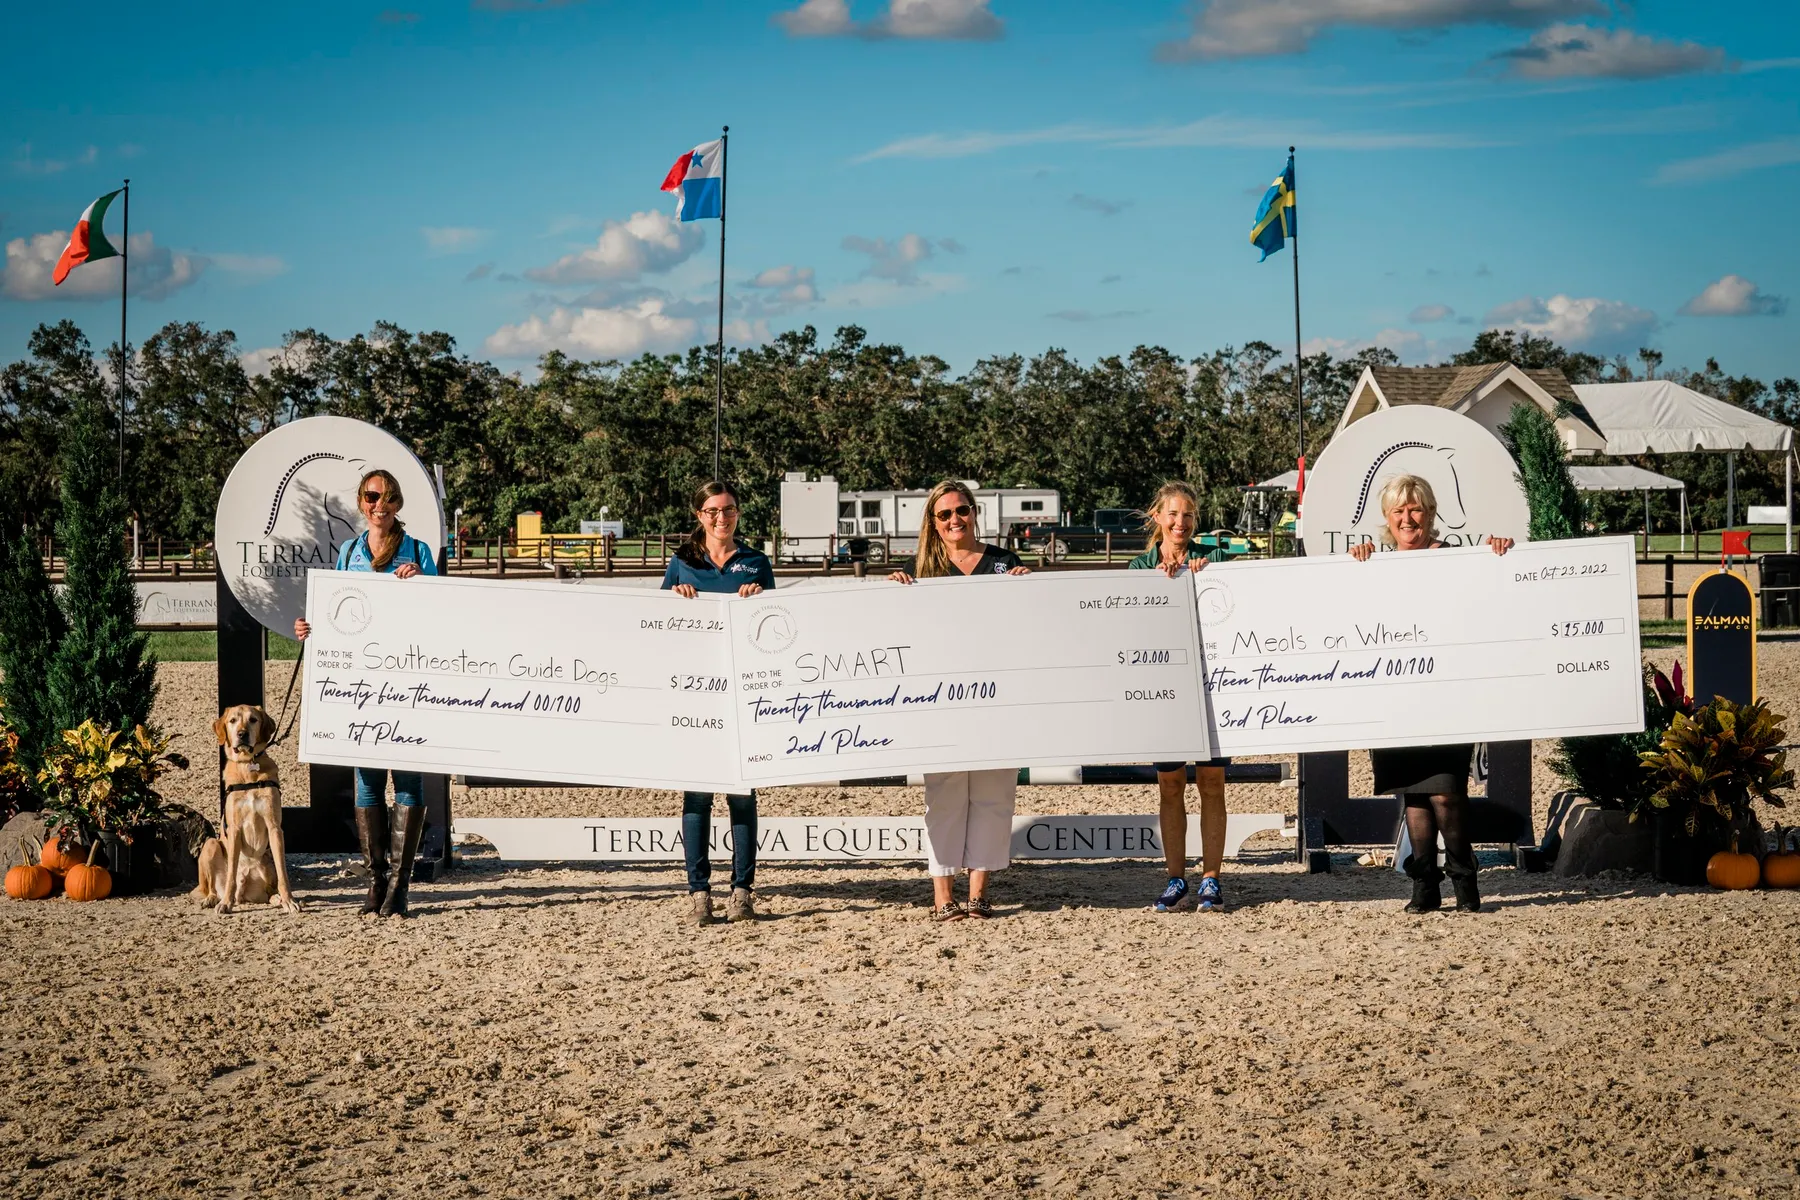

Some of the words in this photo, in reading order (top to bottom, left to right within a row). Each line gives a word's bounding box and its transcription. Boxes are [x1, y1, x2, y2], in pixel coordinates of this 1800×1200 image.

[236, 541, 340, 563] TERRAN
[1515, 572, 1538, 582] DATE
[1581, 563, 1608, 575] 2022
[1079, 600, 1102, 610] DATE
[1144, 595, 1169, 606] 2022
[640, 620, 663, 630] DATE
[1551, 623, 1559, 637] $
[1232, 627, 1307, 655] Meals
[1324, 635, 1348, 649] on
[1355, 623, 1429, 645] Wheels
[317, 650, 328, 658] PAY
[331, 650, 340, 658] TO
[342, 651, 353, 659] THE
[1118, 651, 1125, 665] $
[317, 660, 340, 669] ORDER
[363, 642, 498, 675] Southeastern
[508, 654, 563, 679] Guide
[574, 658, 619, 695] Dogs
[795, 646, 911, 683] SMART
[1252, 659, 1340, 690] thousand
[1341, 657, 1382, 680] and
[1385, 656, 1434, 675] 00/100
[1557, 660, 1610, 673] DOLLARS
[670, 675, 678, 690] $
[742, 672, 754, 680] PAY
[757, 671, 767, 679] TO
[769, 670, 782, 678] THE
[742, 682, 768, 691] ORDER
[1125, 689, 1176, 701] DOLLARS
[408, 682, 492, 709] thousand
[490, 690, 531, 711] and
[533, 693, 581, 713] 00/100
[811, 684, 901, 716] thousand
[902, 682, 943, 704] and
[947, 681, 997, 701] 00/100
[671, 716, 724, 729] DOLLARS
[1219, 706, 1253, 729] 3rd
[1257, 701, 1318, 730] Place
[312, 732, 335, 740] MEMO
[348, 720, 373, 746] 1st
[372, 720, 428, 746] Place
[747, 754, 773, 763] MEMO
[786, 731, 826, 755] 2nd
[831, 725, 894, 755] Place
[805, 825, 925, 857] EQUEST
[1026, 823, 1161, 851] CENTER
